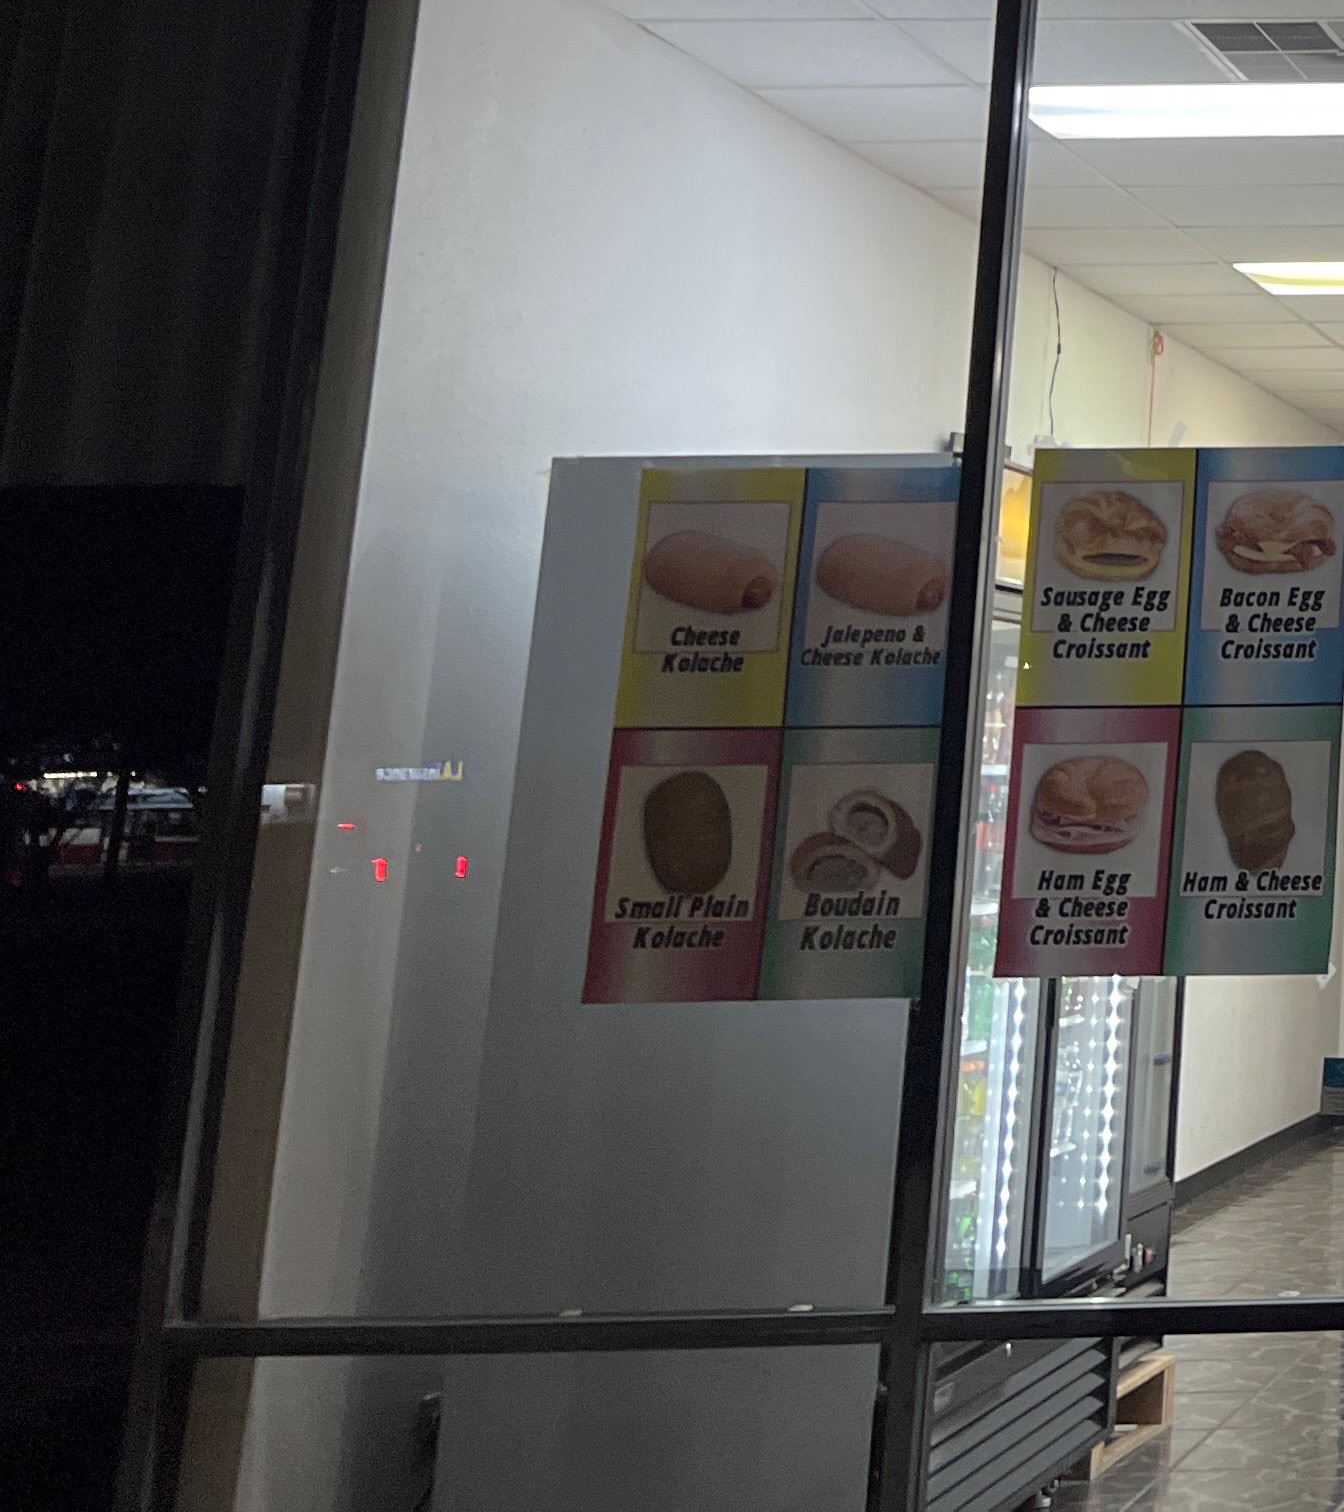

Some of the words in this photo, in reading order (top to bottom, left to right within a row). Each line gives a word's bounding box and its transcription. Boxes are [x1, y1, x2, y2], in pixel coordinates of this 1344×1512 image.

[1041, 586, 1124, 612] Sausage
[1131, 586, 1171, 612] Egg
[1219, 587, 1280, 608] Bacon
[1287, 587, 1326, 612] Egg
[1057, 613, 1073, 633] &
[1080, 611, 1151, 633] Cheese
[1225, 613, 1240, 633] &
[1248, 611, 1317, 633] Cheese
[670, 625, 741, 647] Cheese
[821, 624, 907, 648] Jalepeno
[913, 625, 925, 644] &
[801, 648, 864, 666] Cheese
[869, 646, 941, 666] Kolache
[1052, 638, 1152, 659] Croissant
[1220, 638, 1318, 659] Croissant
[661, 652, 744, 674] Kolache
[1038, 870, 1085, 891] Ham
[1092, 870, 1132, 897] Egg
[1183, 871, 1228, 893] Ham
[1235, 871, 1250, 892] &
[1256, 870, 1322, 892] Cheese
[614, 893, 683, 920] Small
[690, 893, 750, 919] Plain
[804, 890, 901, 918] Boudain
[1035, 897, 1050, 918] &
[1058, 896, 1129, 918] Cheese
[1204, 897, 1297, 920] Croissant
[632, 924, 726, 950] Kolache
[800, 923, 897, 951] Kolache
[1029, 923, 1129, 946] Croissant
